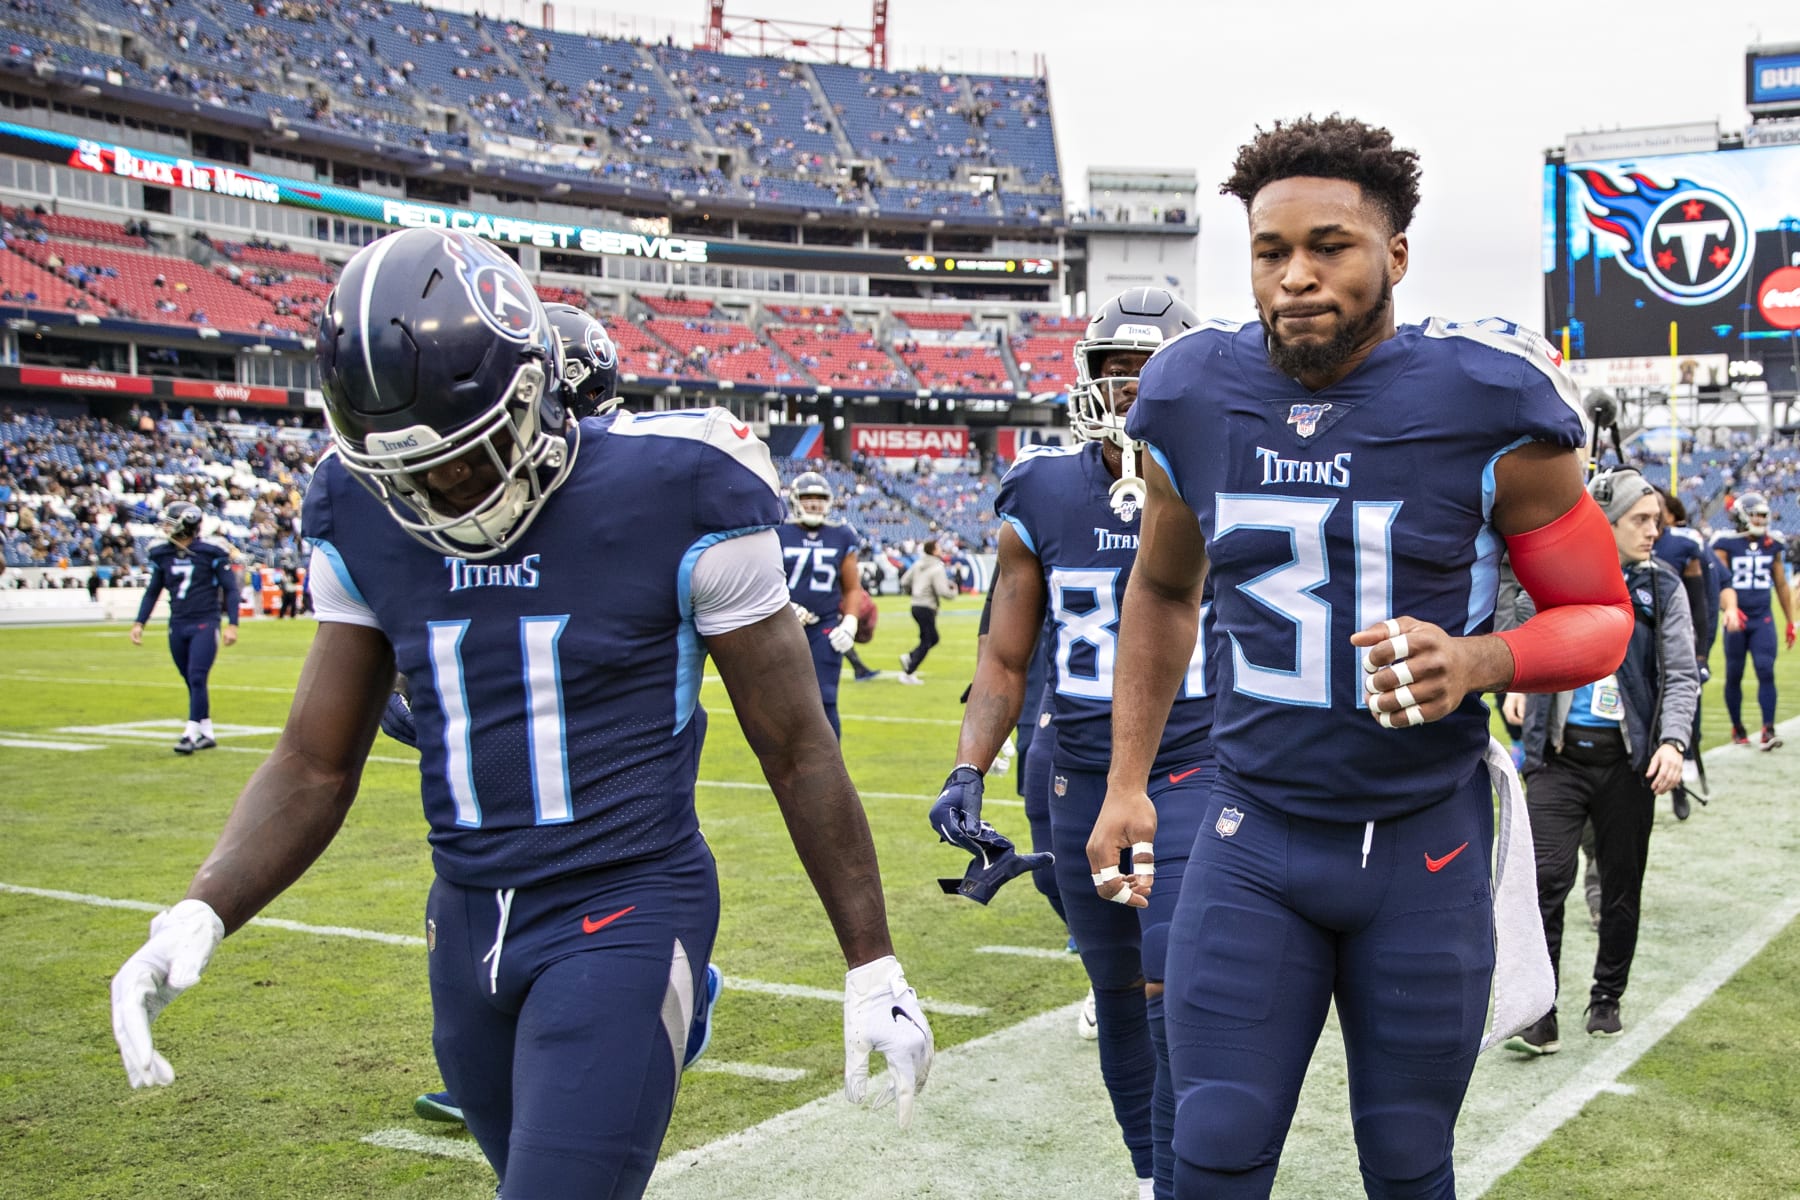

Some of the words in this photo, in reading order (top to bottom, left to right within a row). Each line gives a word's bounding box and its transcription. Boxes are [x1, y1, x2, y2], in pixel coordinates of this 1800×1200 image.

[114, 146, 175, 184] BLACK
[176, 158, 211, 191] TIE
[215, 167, 279, 203] MOVING
[383, 200, 446, 229] RED
[452, 211, 574, 249] CARPET
[580, 229, 707, 262] SERVICE
[1128, 326, 1151, 336] TITANS
[61, 373, 117, 389] NISSAN
[378, 434, 419, 452] TITANS
[858, 430, 963, 450] NISSAN
[1256, 446, 1352, 488] TITANS
[171, 565, 195, 600] 7
[444, 553, 541, 592] TITANS
[783, 547, 839, 592] 75
[1731, 555, 1773, 590] 85
[1213, 492, 1404, 709] 31
[426, 614, 575, 829] 11
